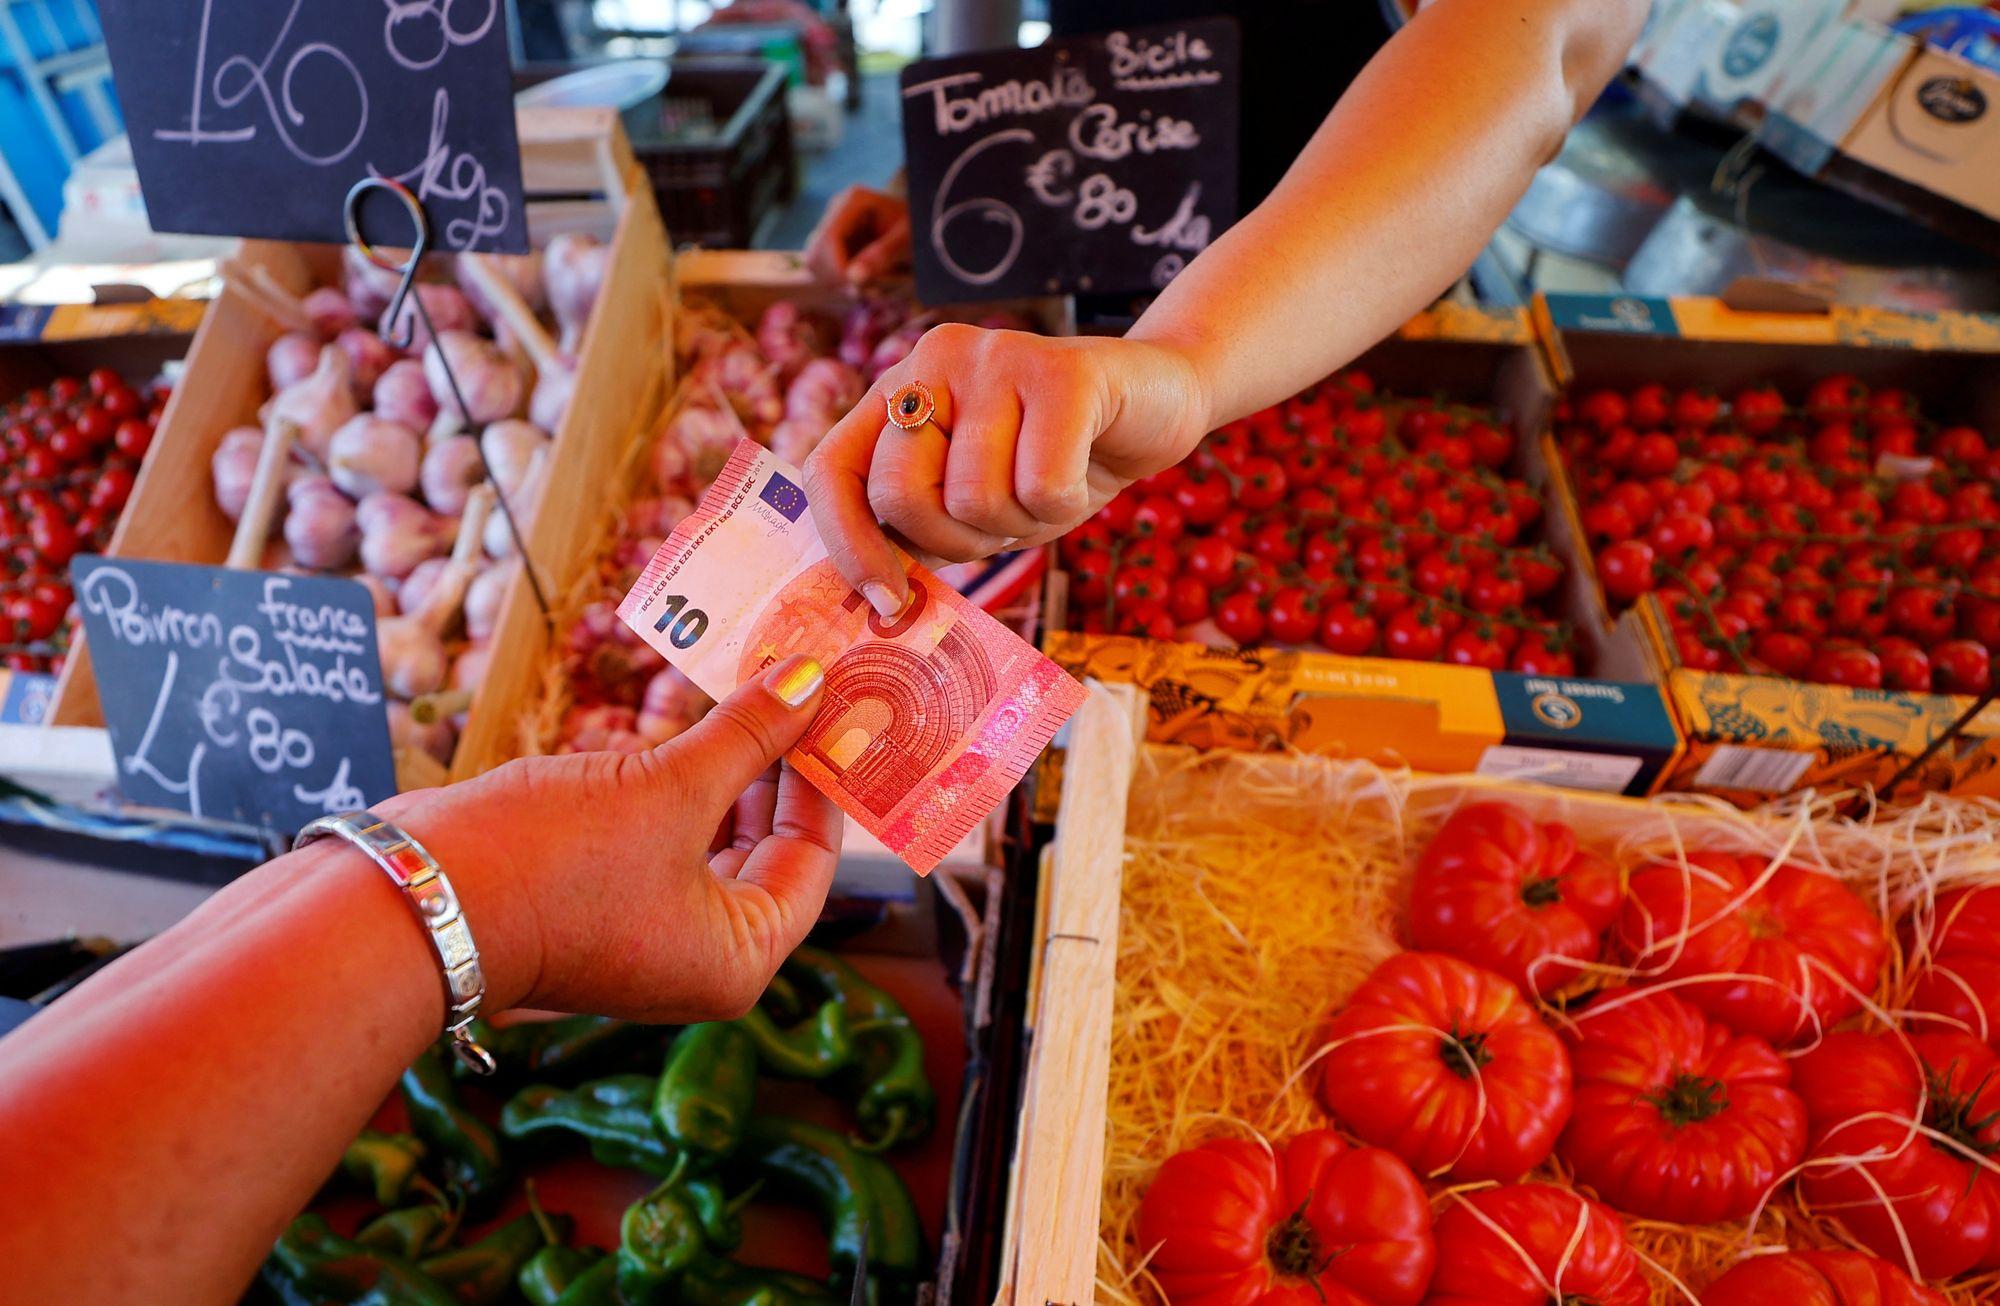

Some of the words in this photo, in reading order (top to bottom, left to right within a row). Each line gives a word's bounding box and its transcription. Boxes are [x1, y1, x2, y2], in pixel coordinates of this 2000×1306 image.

[1105, 30, 1213, 78] Sicile
[1068, 102, 1200, 161] Cerise
[931, 128, 1036, 286] 6
[1073, 173, 1138, 230] 80
[741, 476, 756, 494] EBC
[81, 566, 224, 645] Poivron
[257, 576, 368, 636] France
[653, 594, 709, 649] 10
[219, 625, 382, 704] Salade
[247, 707, 315, 773] 80
